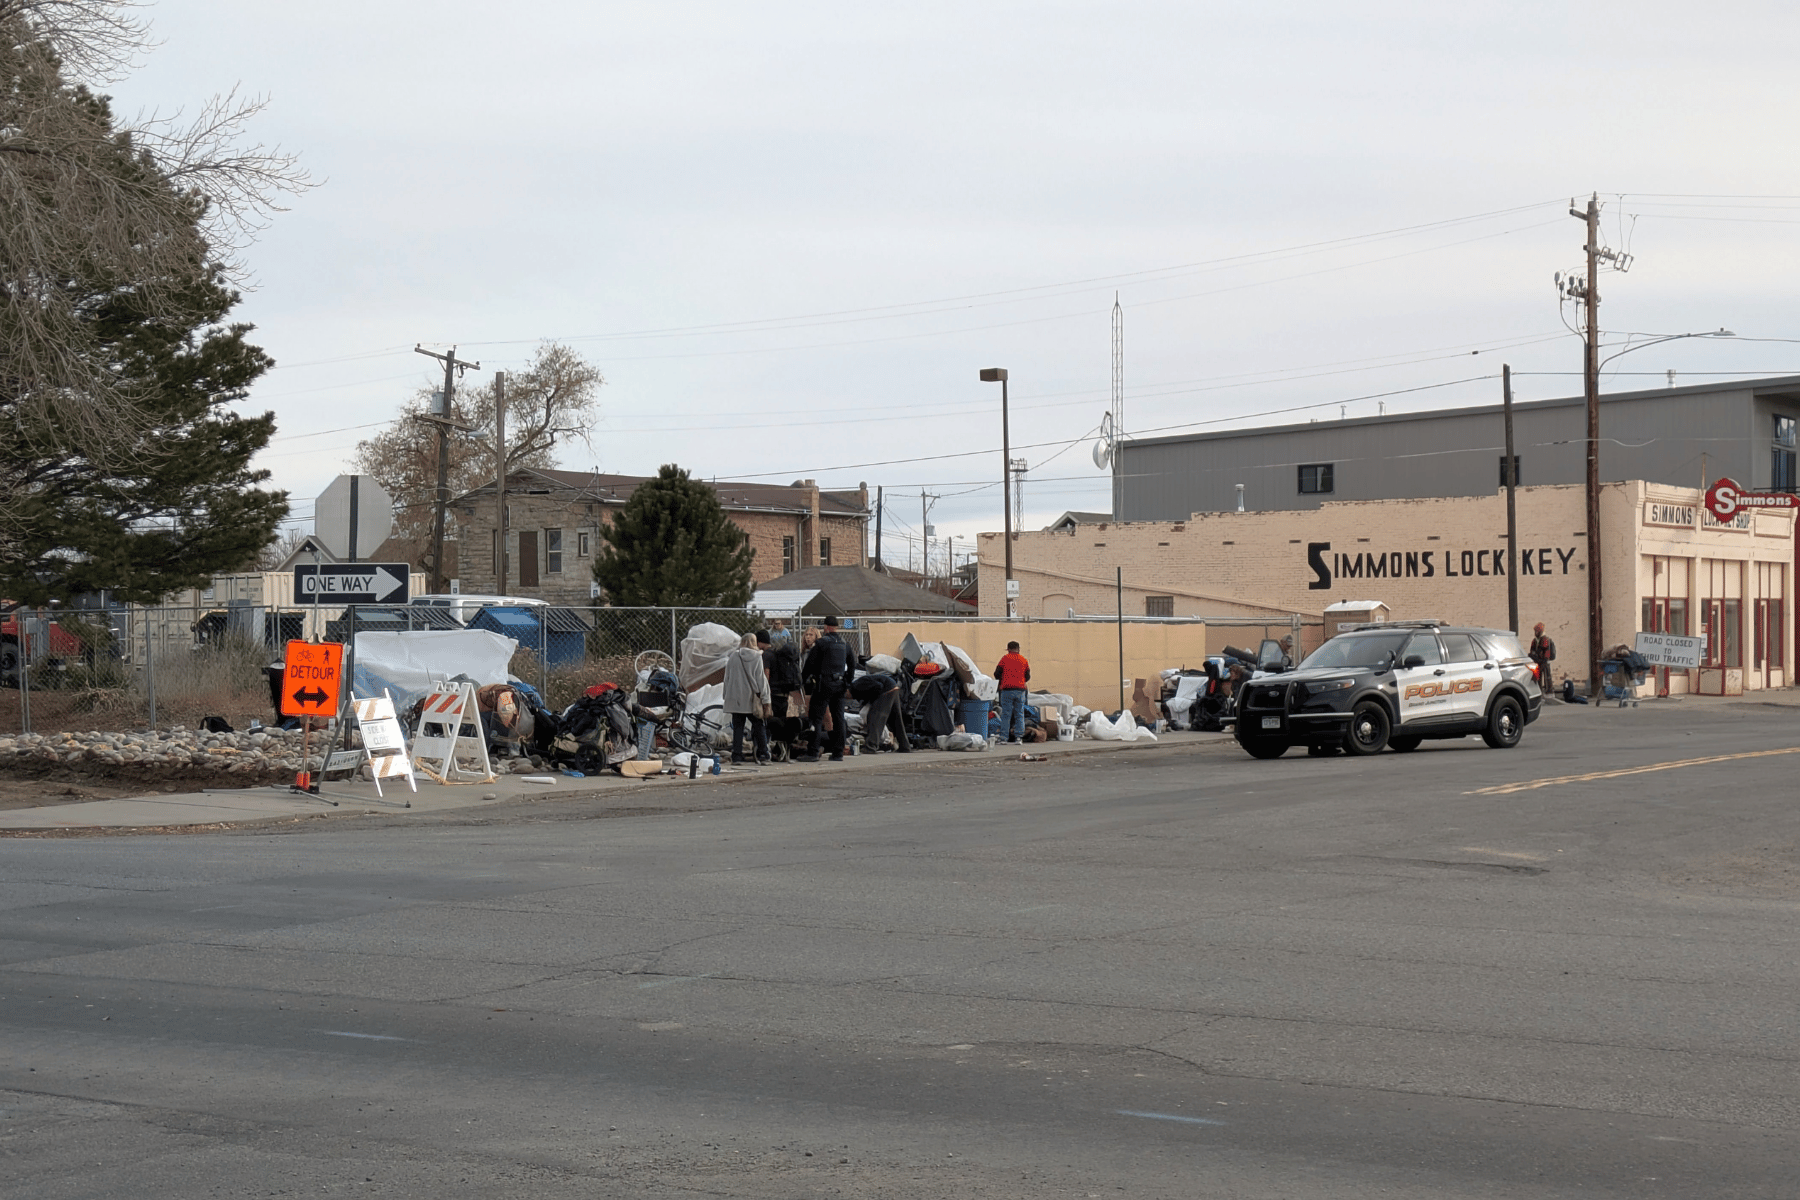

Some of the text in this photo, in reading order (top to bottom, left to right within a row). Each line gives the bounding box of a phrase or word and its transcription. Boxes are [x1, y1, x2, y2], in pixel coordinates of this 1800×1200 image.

[1715, 487, 1792, 514] Simmons
[1652, 504, 1692, 525] SIMMONS
[1308, 542, 1576, 590] SIMMONS LOCK KEY
[306, 576, 373, 592] ONE WAY
[1644, 636, 1663, 645] ROAD
[1665, 638, 1693, 648] CLOSED
[1664, 647, 1672, 655] TO
[1663, 654, 1694, 665] TRAFFIC
[290, 665, 335, 681] DETOUR
[1404, 677, 1484, 700] POLICE
